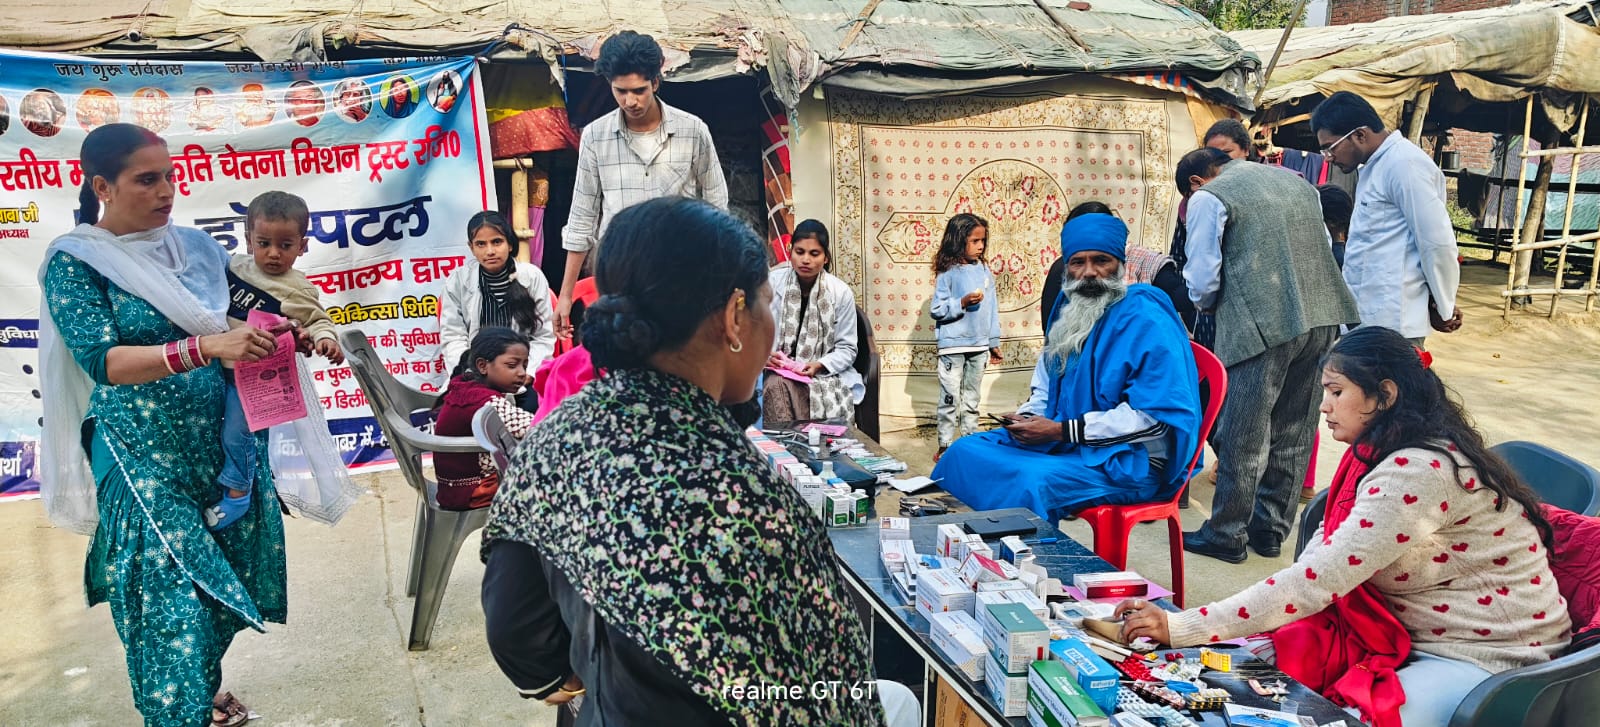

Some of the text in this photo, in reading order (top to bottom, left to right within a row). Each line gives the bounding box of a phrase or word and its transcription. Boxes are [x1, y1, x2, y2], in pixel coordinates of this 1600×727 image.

[54, 63, 84, 76] जय
[126, 62, 184, 76] रविदास
[225, 63, 254, 73] जय
[219, 144, 287, 182] चेतना
[291, 137, 361, 176] मिशन
[366, 140, 409, 183] ट्रस्ट
[21, 201, 39, 222] जी
[379, 329, 397, 347] की
[400, 328, 440, 353] सुविधा
[327, 367, 352, 387] पुरू
[411, 361, 430, 373] का
